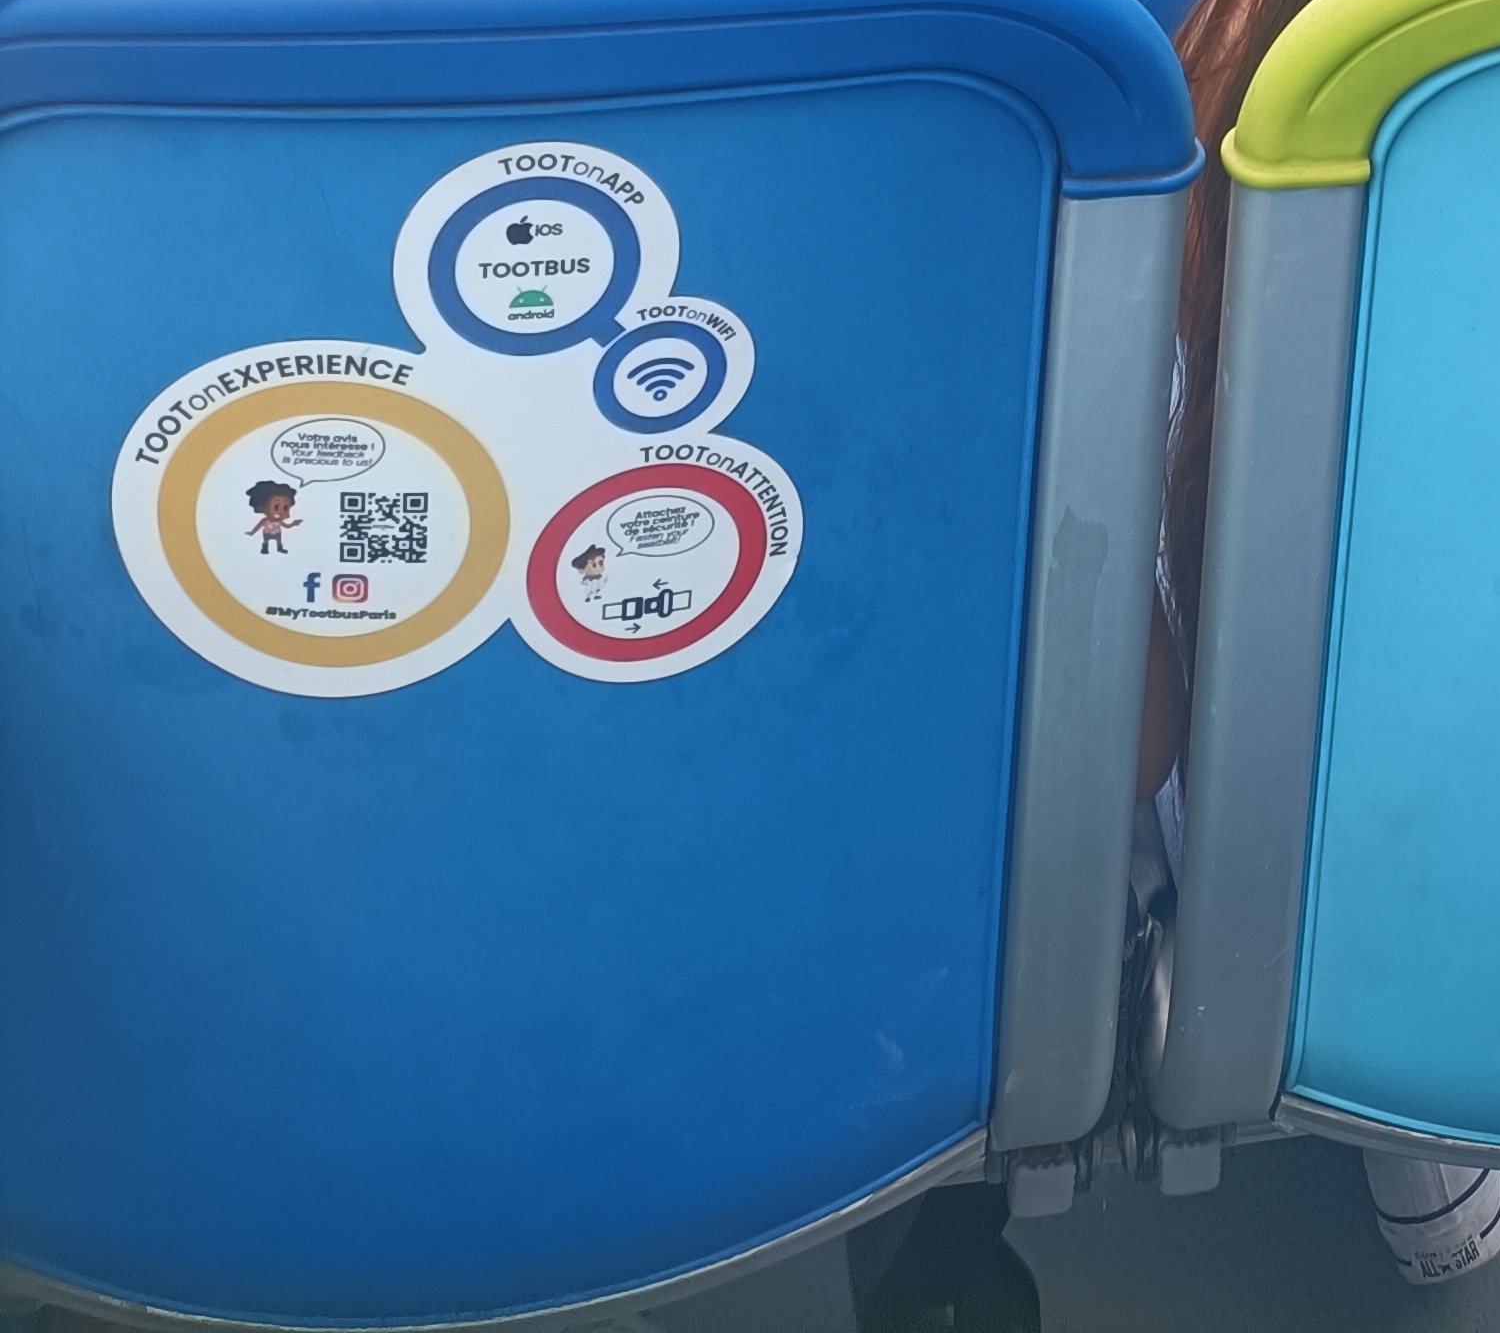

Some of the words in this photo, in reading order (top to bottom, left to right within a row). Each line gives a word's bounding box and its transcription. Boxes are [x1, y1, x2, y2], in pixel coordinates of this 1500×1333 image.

[498, 153, 646, 206] TOOTonAPP
[478, 258, 591, 279] TOOTBUS
[507, 309, 555, 321] android
[636, 305, 737, 342] TOOTonWIFI
[135, 354, 414, 465] TOOTonEXPERIENCE
[280, 440, 310, 450] nous
[333, 433, 358, 443] avis
[639, 444, 789, 558] TOOTonATTENTION
[264, 606, 397, 622] #MyTootbusParis
[1420, 1260, 1441, 1278] ALL
[1451, 1240, 1481, 1270] STAR
